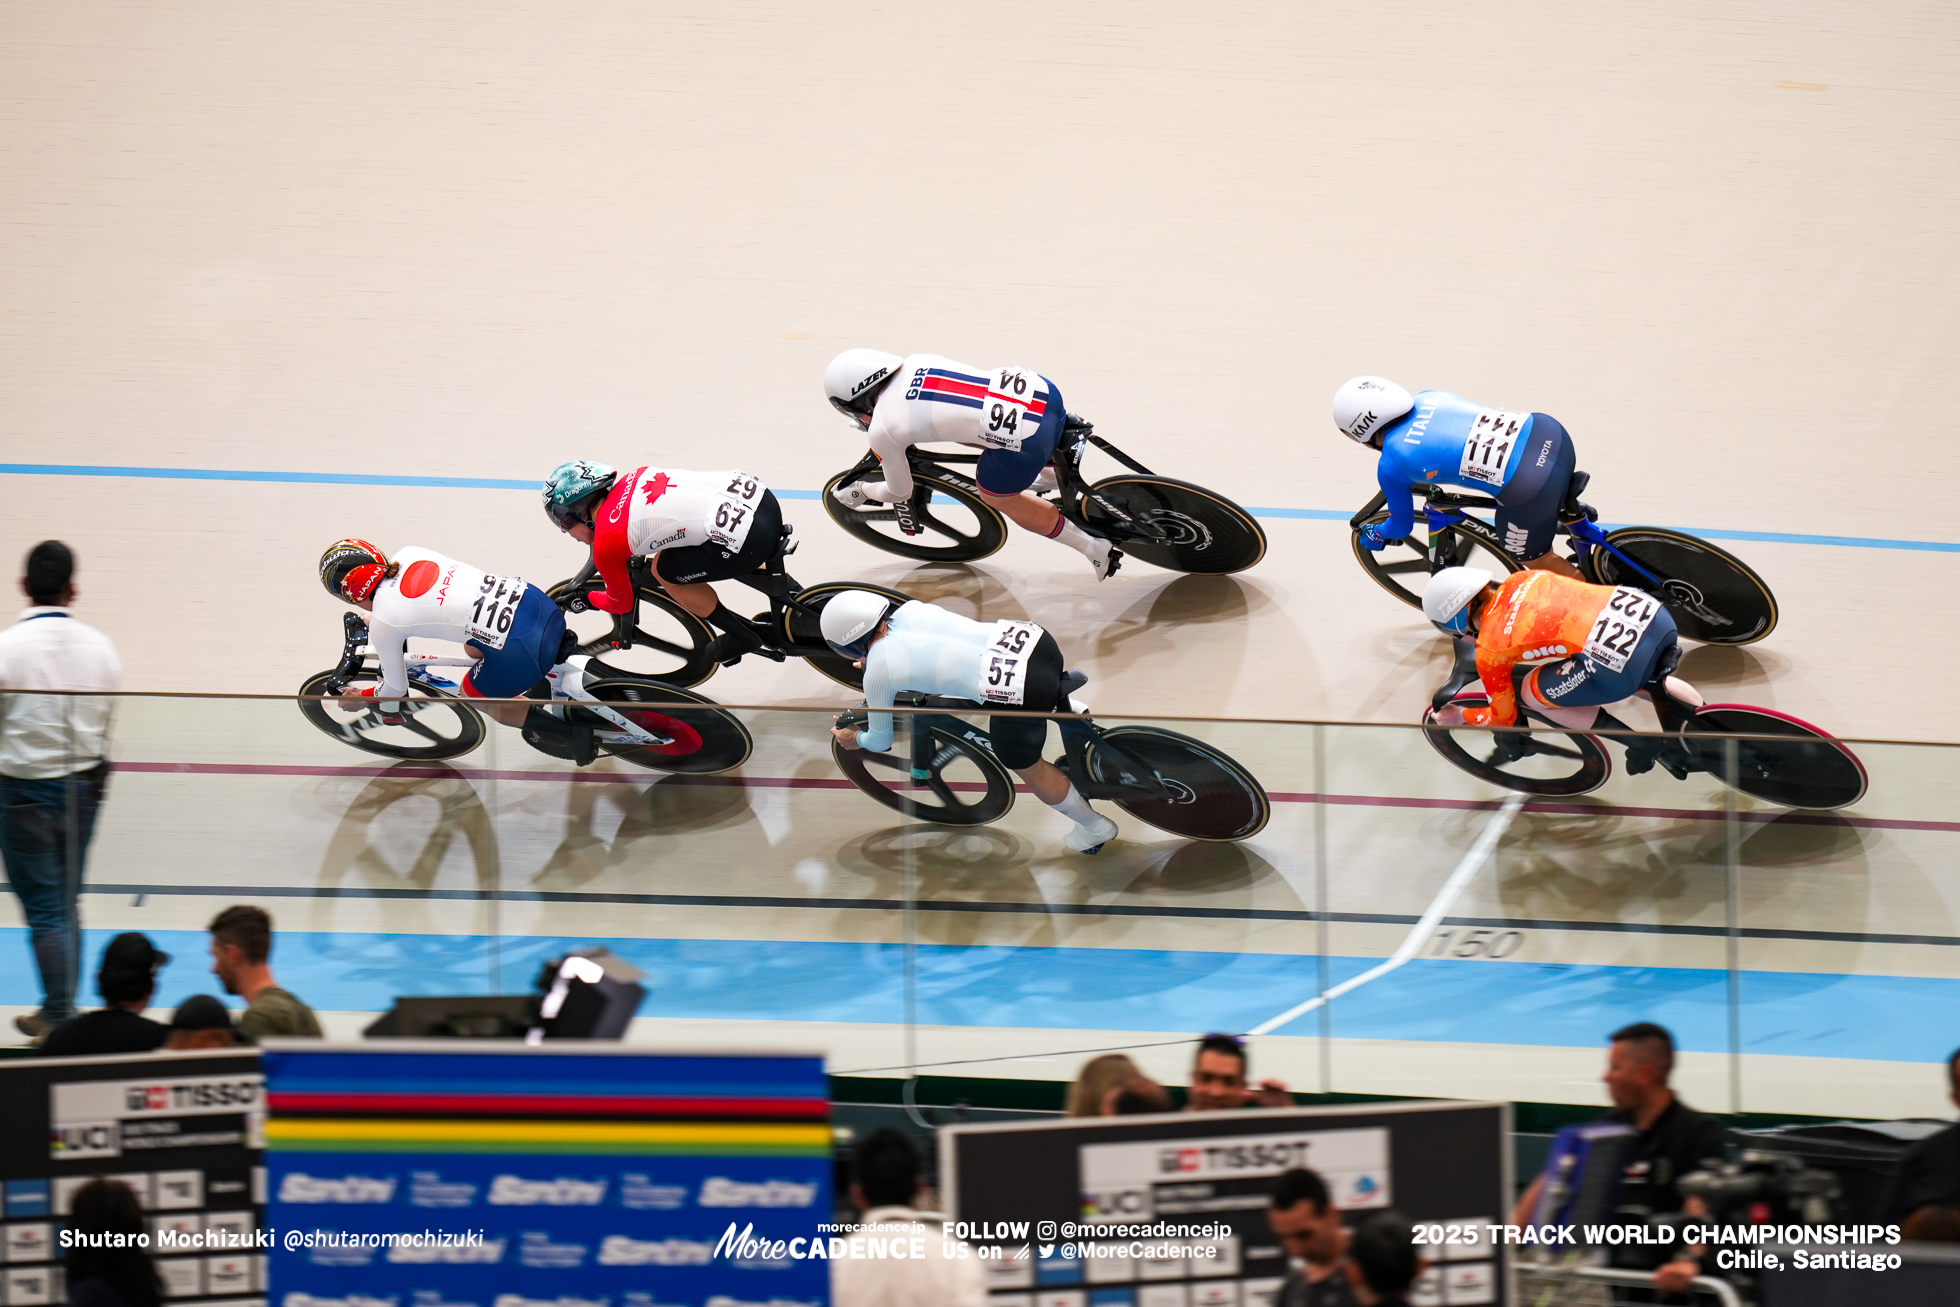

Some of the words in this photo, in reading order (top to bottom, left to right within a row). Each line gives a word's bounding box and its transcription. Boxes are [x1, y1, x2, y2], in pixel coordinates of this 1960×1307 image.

[851, 367, 888, 396] LAZER
[905, 367, 929, 400] GBR
[989, 403, 1018, 435] 94
[1403, 399, 1442, 445] ITALIA
[1468, 434, 1509, 470] 111
[1536, 440, 1553, 468] TOYOTA
[1476, 467, 1496, 477] TISSOT
[564, 480, 592, 499] Dragonfly
[609, 469, 638, 523] Canada
[715, 501, 746, 533] 67
[649, 529, 686, 550] Canada
[359, 566, 382, 596] JAPAN
[436, 563, 459, 606] JAPAN
[472, 595, 514, 633] 116
[1441, 587, 1472, 619] LAZER
[842, 621, 866, 642] LAZER
[1595, 617, 1638, 658] 122
[988, 657, 1018, 687] 57
[1599, 651, 1619, 663] TISSOT
[1431, 930, 1525, 958] 150
